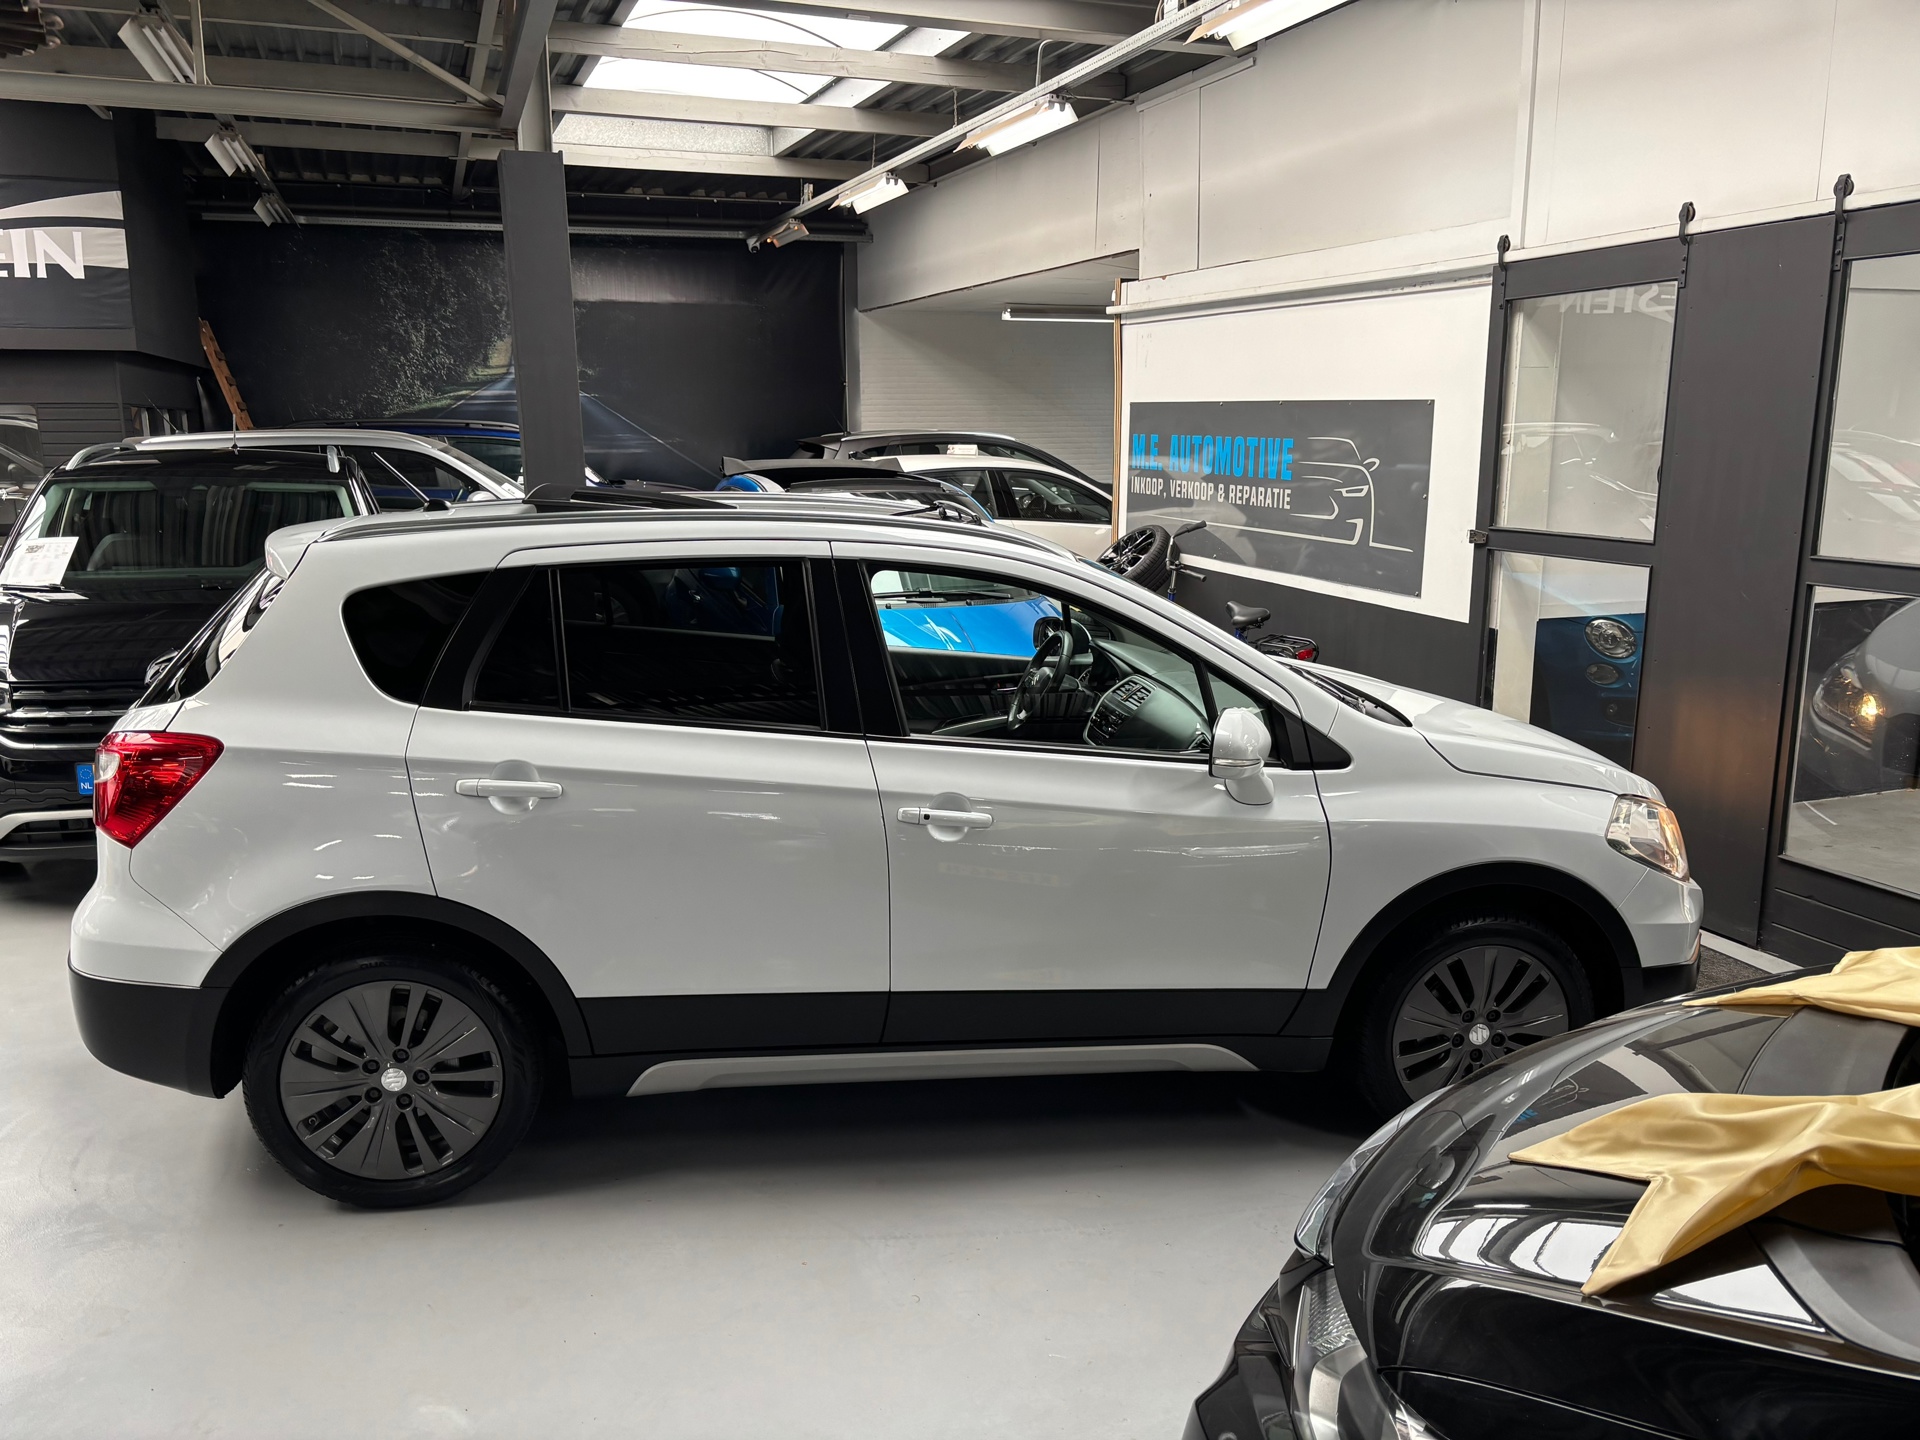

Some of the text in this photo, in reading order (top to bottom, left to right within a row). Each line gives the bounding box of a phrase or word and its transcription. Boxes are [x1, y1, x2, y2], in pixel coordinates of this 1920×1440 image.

[1131, 433, 1294, 481] M.E. AUTOMOTIVE
[1130, 476, 1292, 510] INKOOP, VERKOOP & REPARATIE
[80, 782, 93, 790] NL
